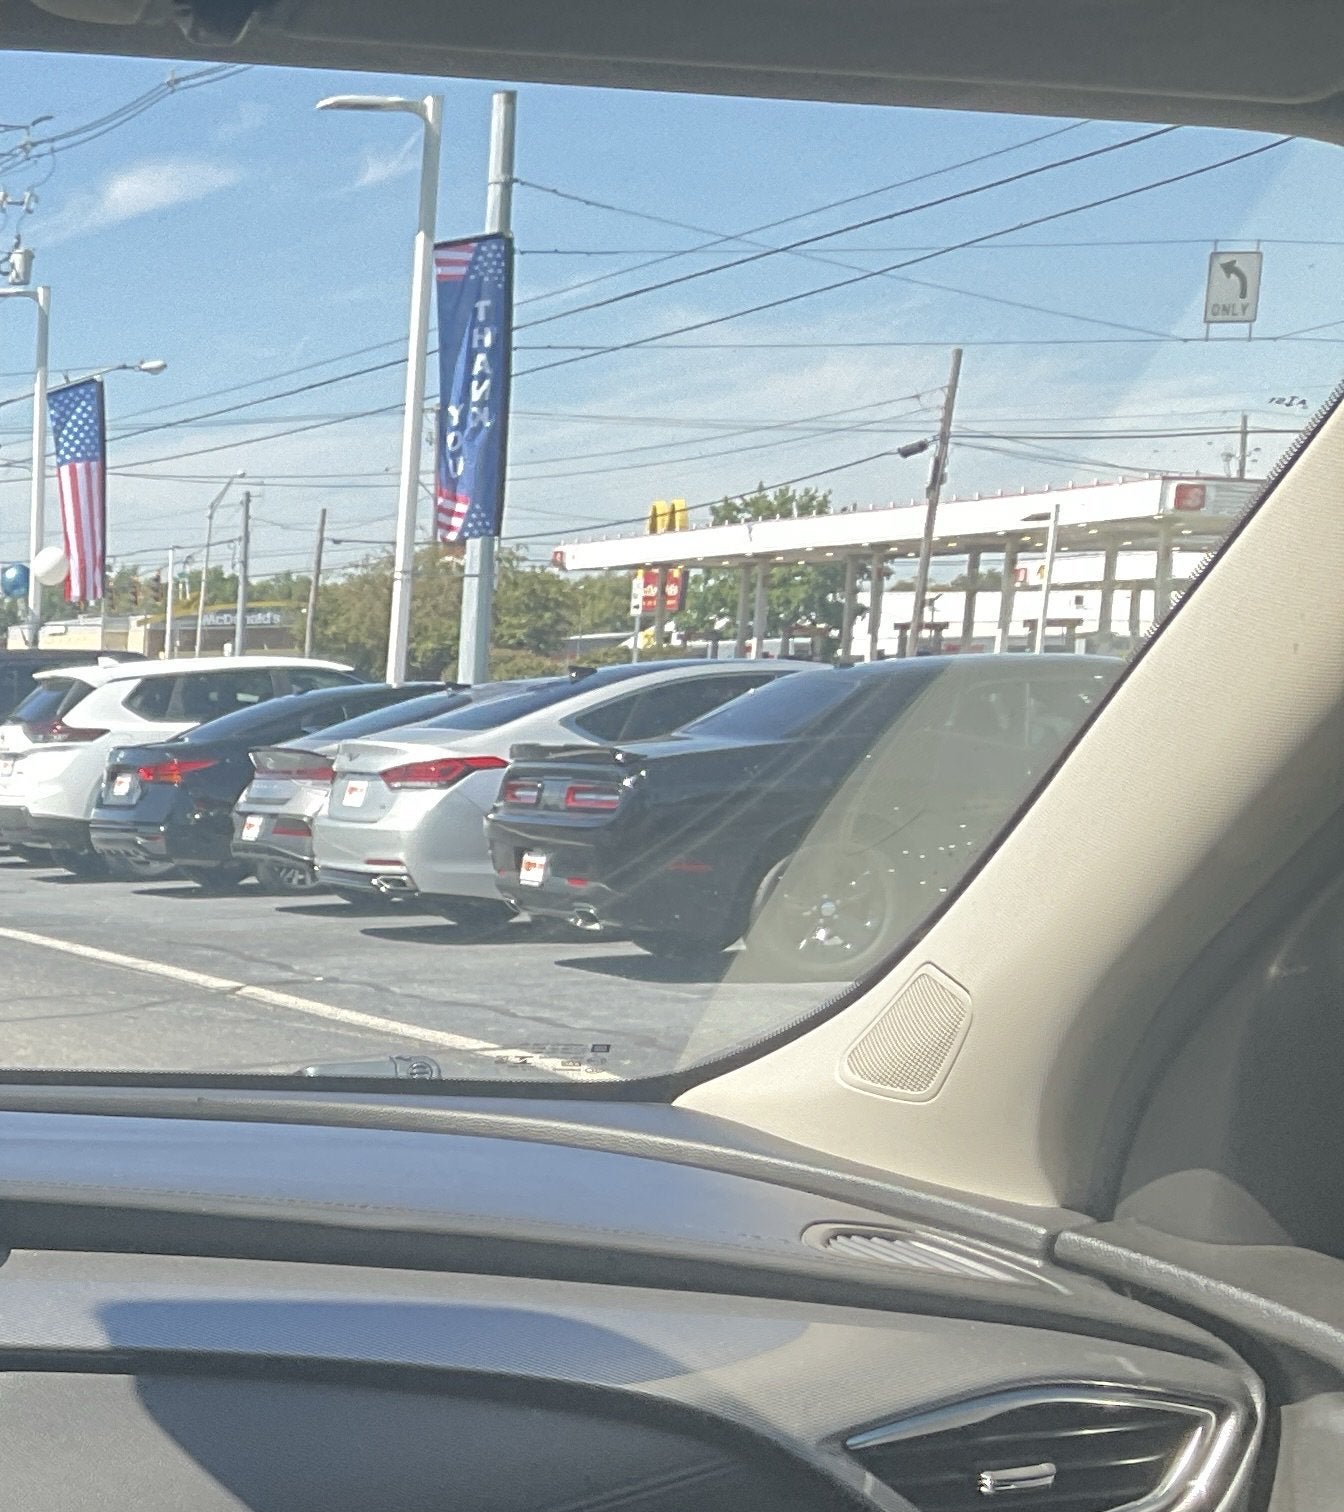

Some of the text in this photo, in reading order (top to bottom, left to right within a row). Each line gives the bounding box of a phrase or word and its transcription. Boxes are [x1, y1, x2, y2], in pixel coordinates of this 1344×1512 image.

[1211, 303, 1250, 317] ONLY
[471, 299, 495, 428] THANK
[446, 403, 465, 479] YOU
